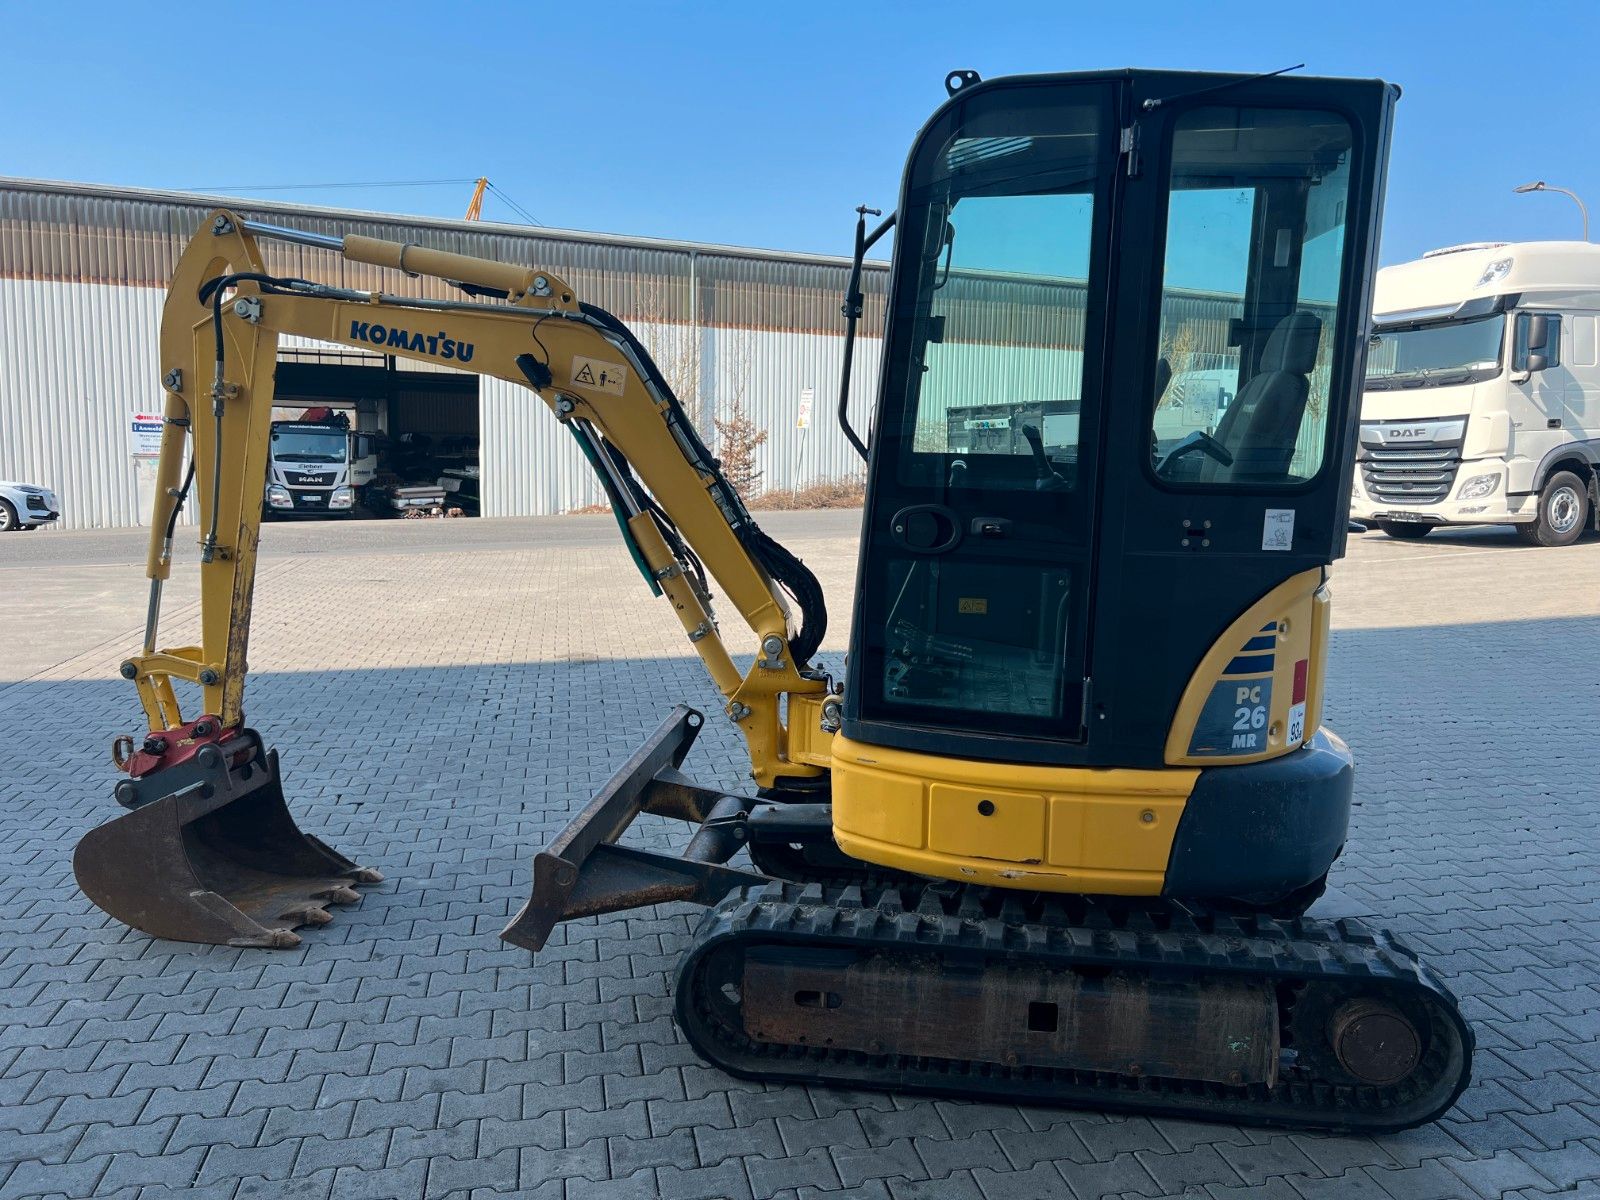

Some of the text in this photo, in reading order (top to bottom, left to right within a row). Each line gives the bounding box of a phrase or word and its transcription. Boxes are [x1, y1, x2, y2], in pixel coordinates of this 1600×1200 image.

[350, 320, 474, 362] KOMATSU
[1389, 428, 1426, 438] DAF
[1236, 686, 1261, 705] PC
[1233, 706, 1266, 730] 26
[1231, 733, 1257, 749] MR
